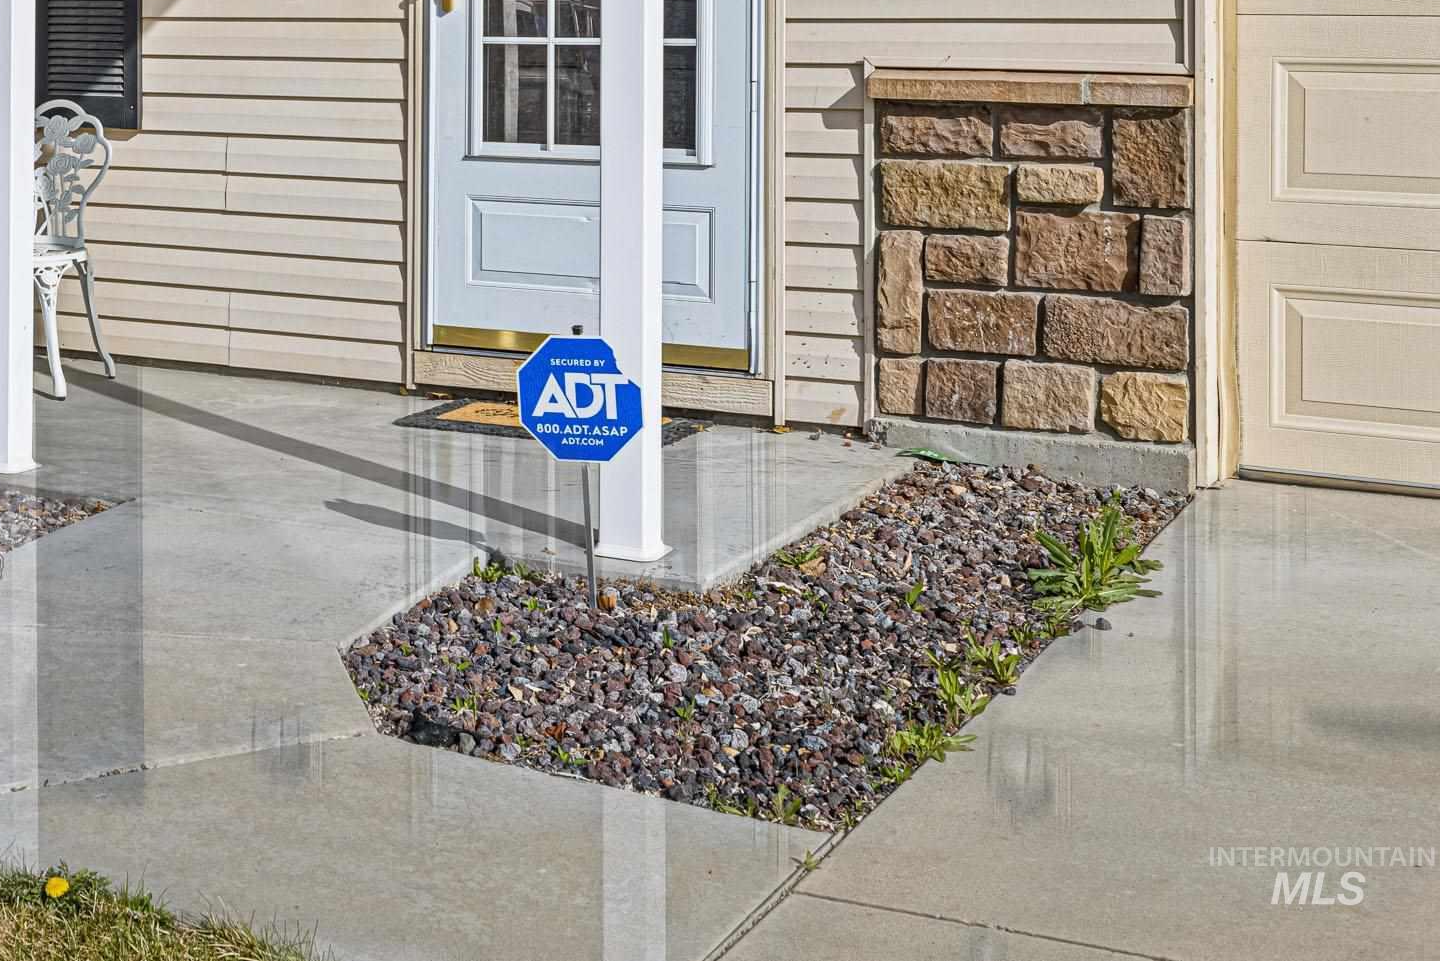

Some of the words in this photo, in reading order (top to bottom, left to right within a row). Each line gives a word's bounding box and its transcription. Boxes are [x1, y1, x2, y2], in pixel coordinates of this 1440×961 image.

[550, 358, 591, 367] SECURED
[594, 359, 605, 367] BY
[531, 372, 629, 420] ADT
[536, 423, 628, 437] 800.ADT.ASAP
[561, 437, 604, 446] ADT.COM
